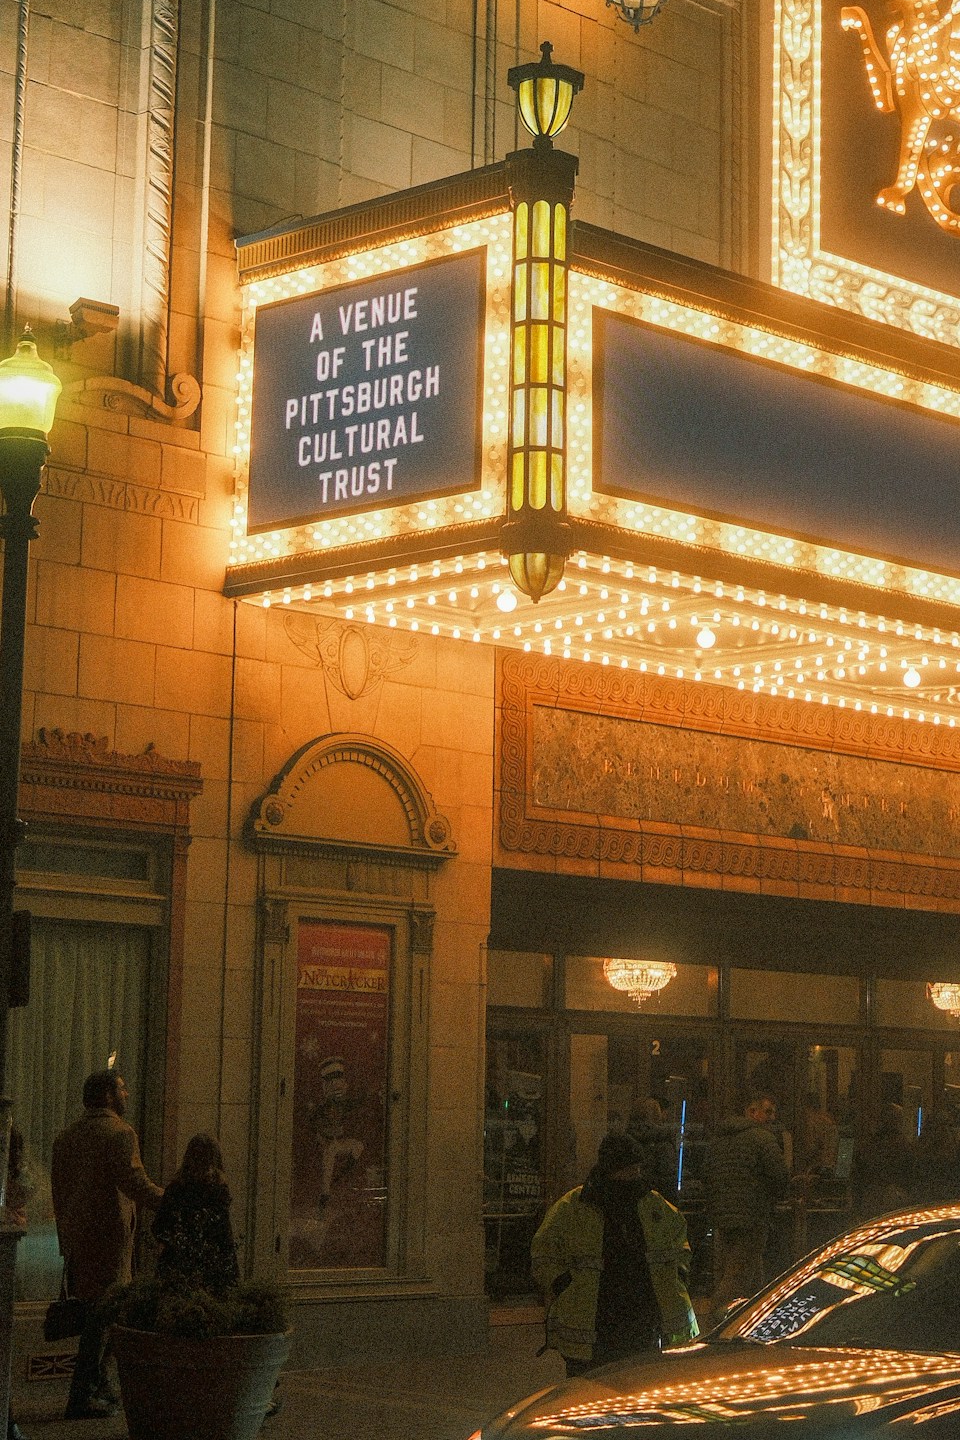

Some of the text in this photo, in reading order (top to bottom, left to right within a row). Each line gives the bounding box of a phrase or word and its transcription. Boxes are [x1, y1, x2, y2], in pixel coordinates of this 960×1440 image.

[309, 287, 418, 343] A VENUE
[316, 331, 409, 382] OF THE
[285, 365, 440, 429] PITTSBURGH
[298, 412, 424, 467] CULTURAL
[319, 458, 398, 503] TRUST
[651, 1040, 661, 1056] 2
